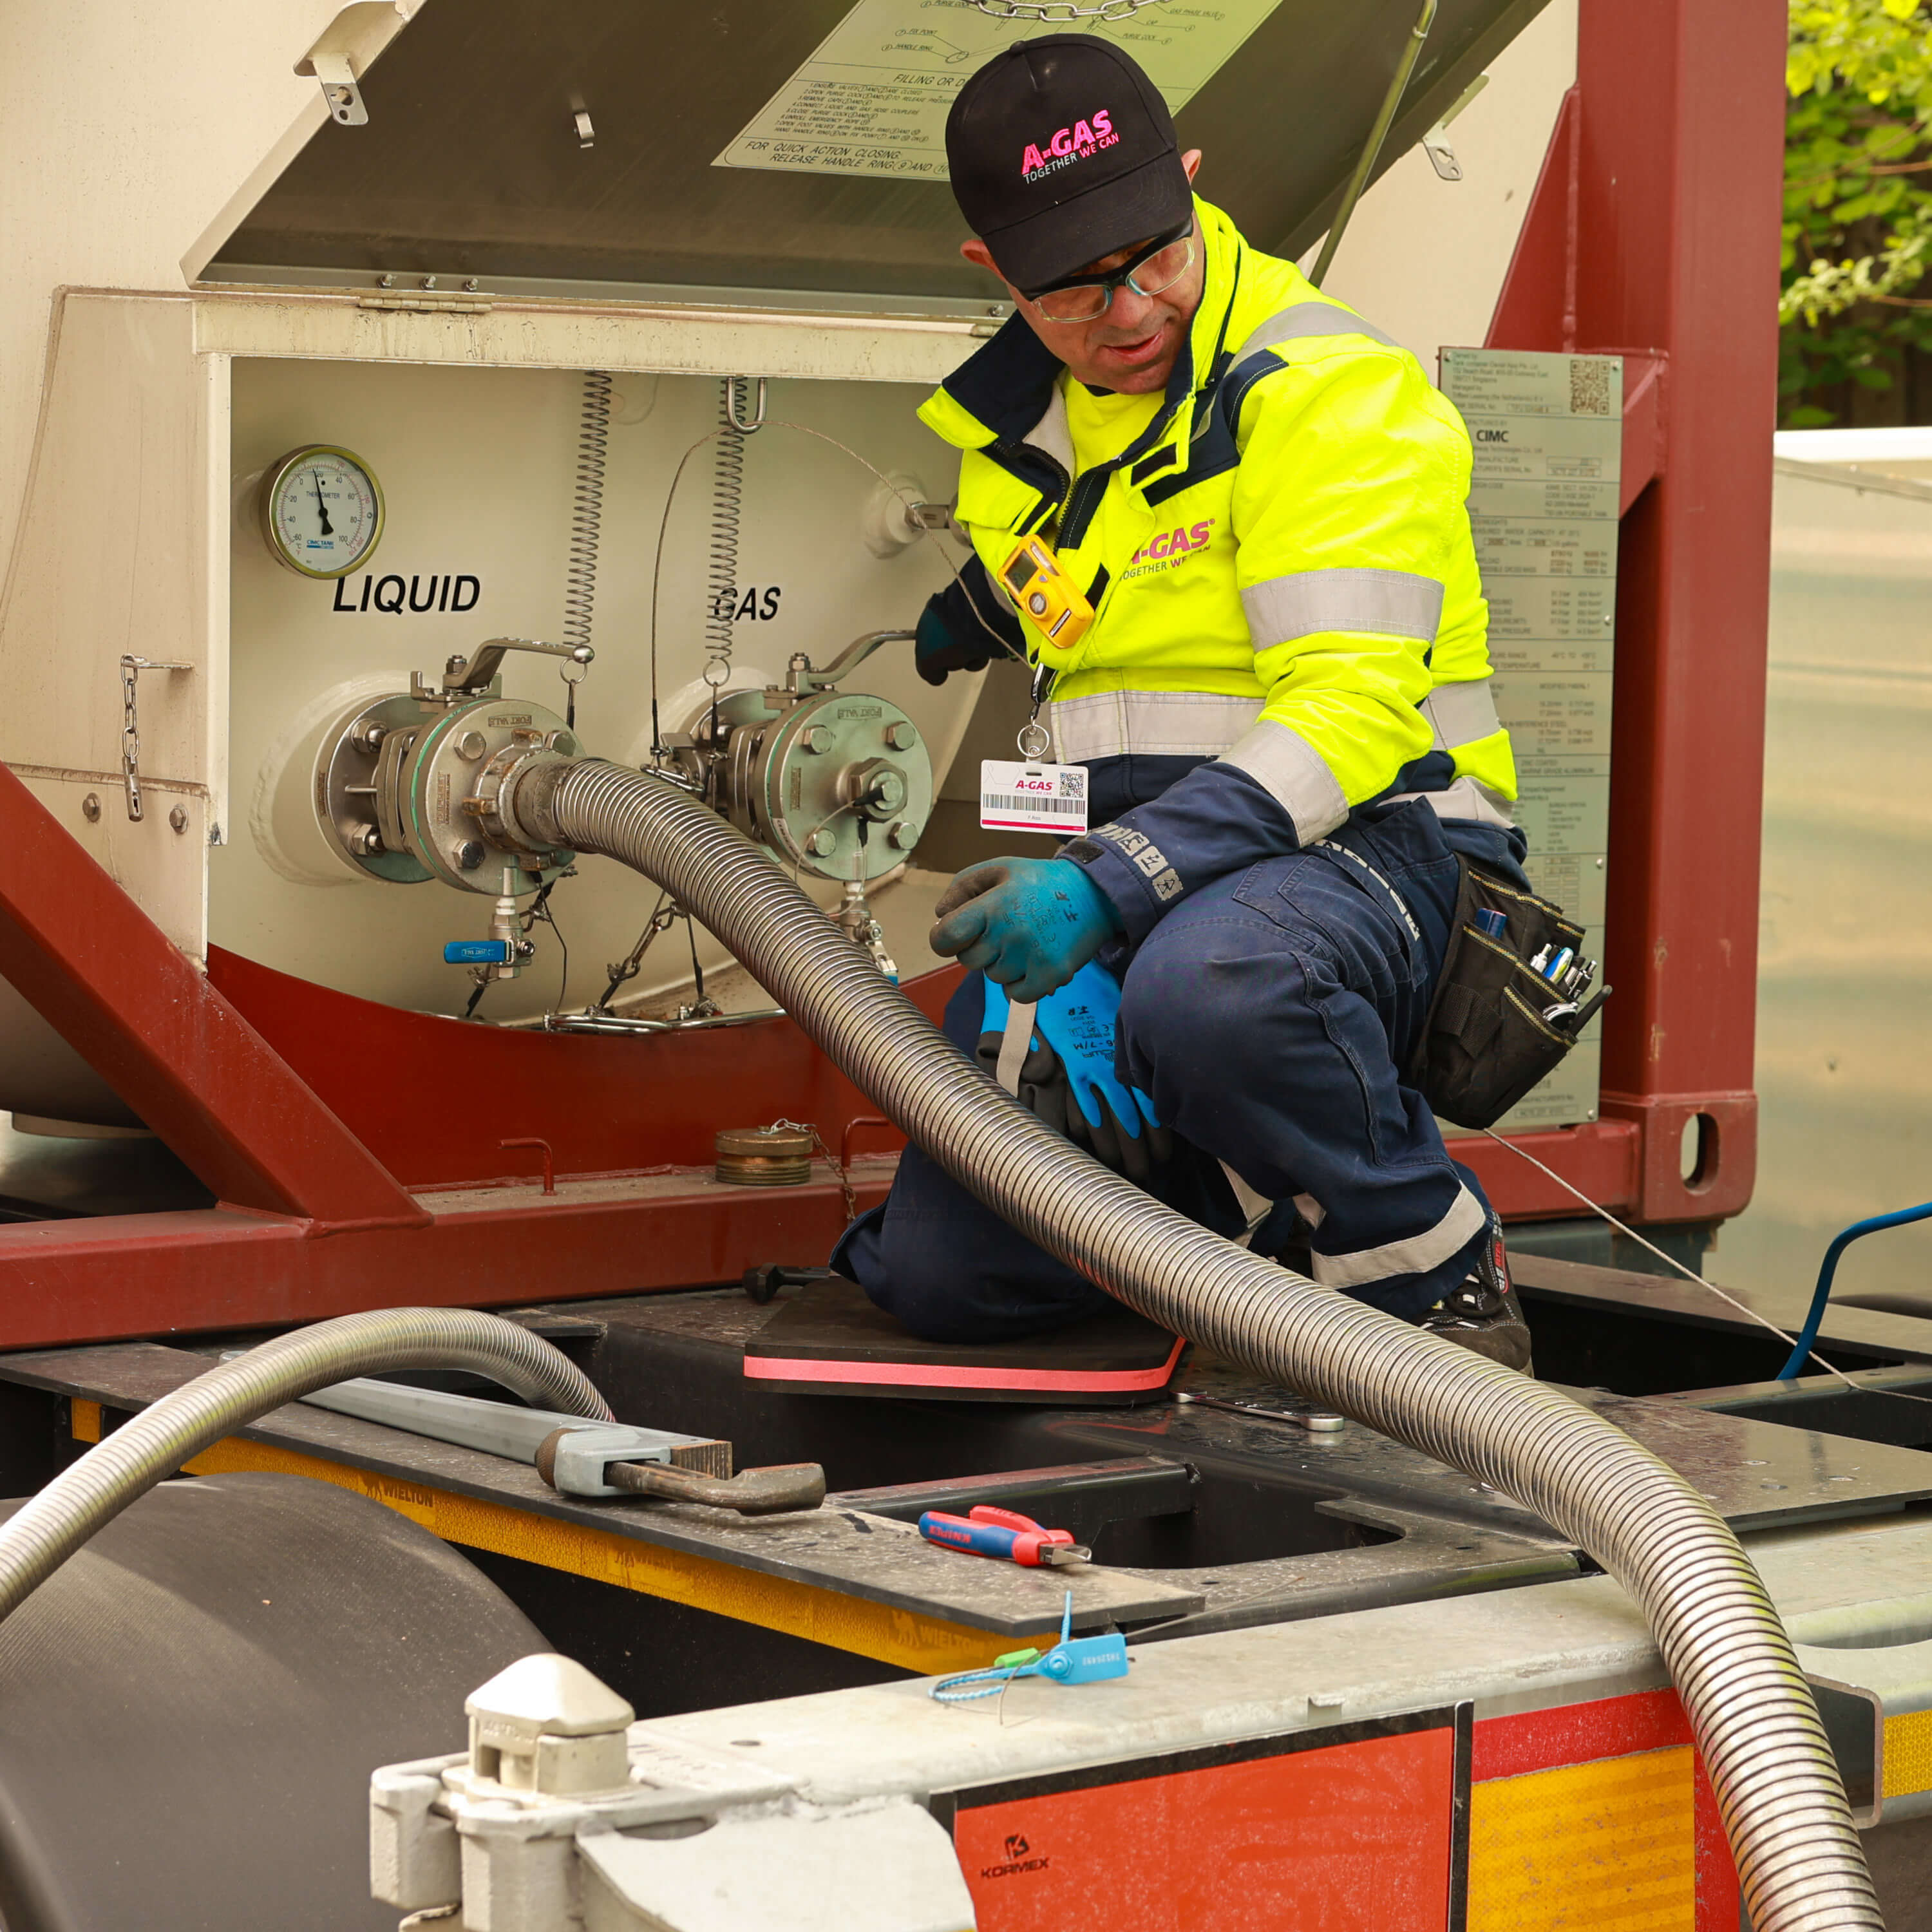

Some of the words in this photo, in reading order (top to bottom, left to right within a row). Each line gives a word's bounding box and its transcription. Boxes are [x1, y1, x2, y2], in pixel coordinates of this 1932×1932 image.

[893, 73, 935, 85] FILLING
[937, 77, 954, 86] OR
[744, 141, 769, 150] FOR
[773, 143, 806, 153] QUICK
[812, 146, 851, 156] ACTION
[1021, 109, 1112, 175] A-GAS
[770, 153, 819, 165] RELEASE
[822, 157, 863, 167] HANDLE
[1023, 152, 1077, 184] TOGETHER
[1079, 144, 1097, 158] WE
[1099, 132, 1119, 149] CAN
[1476, 430, 1509, 443] CIMC
[306, 490, 340, 499] THEROMETER
[333, 574, 480, 615] LIQUID
[714, 587, 781, 621] GAS
[838, 708, 859, 718] VALE
[860, 707, 882, 717] FORT
[512, 716, 531, 725] FORT
[1016, 780, 1053, 791] A-GAS
[384, 1483, 434, 1508] WIELTON
[980, 1857, 1050, 1879] KORMEX
